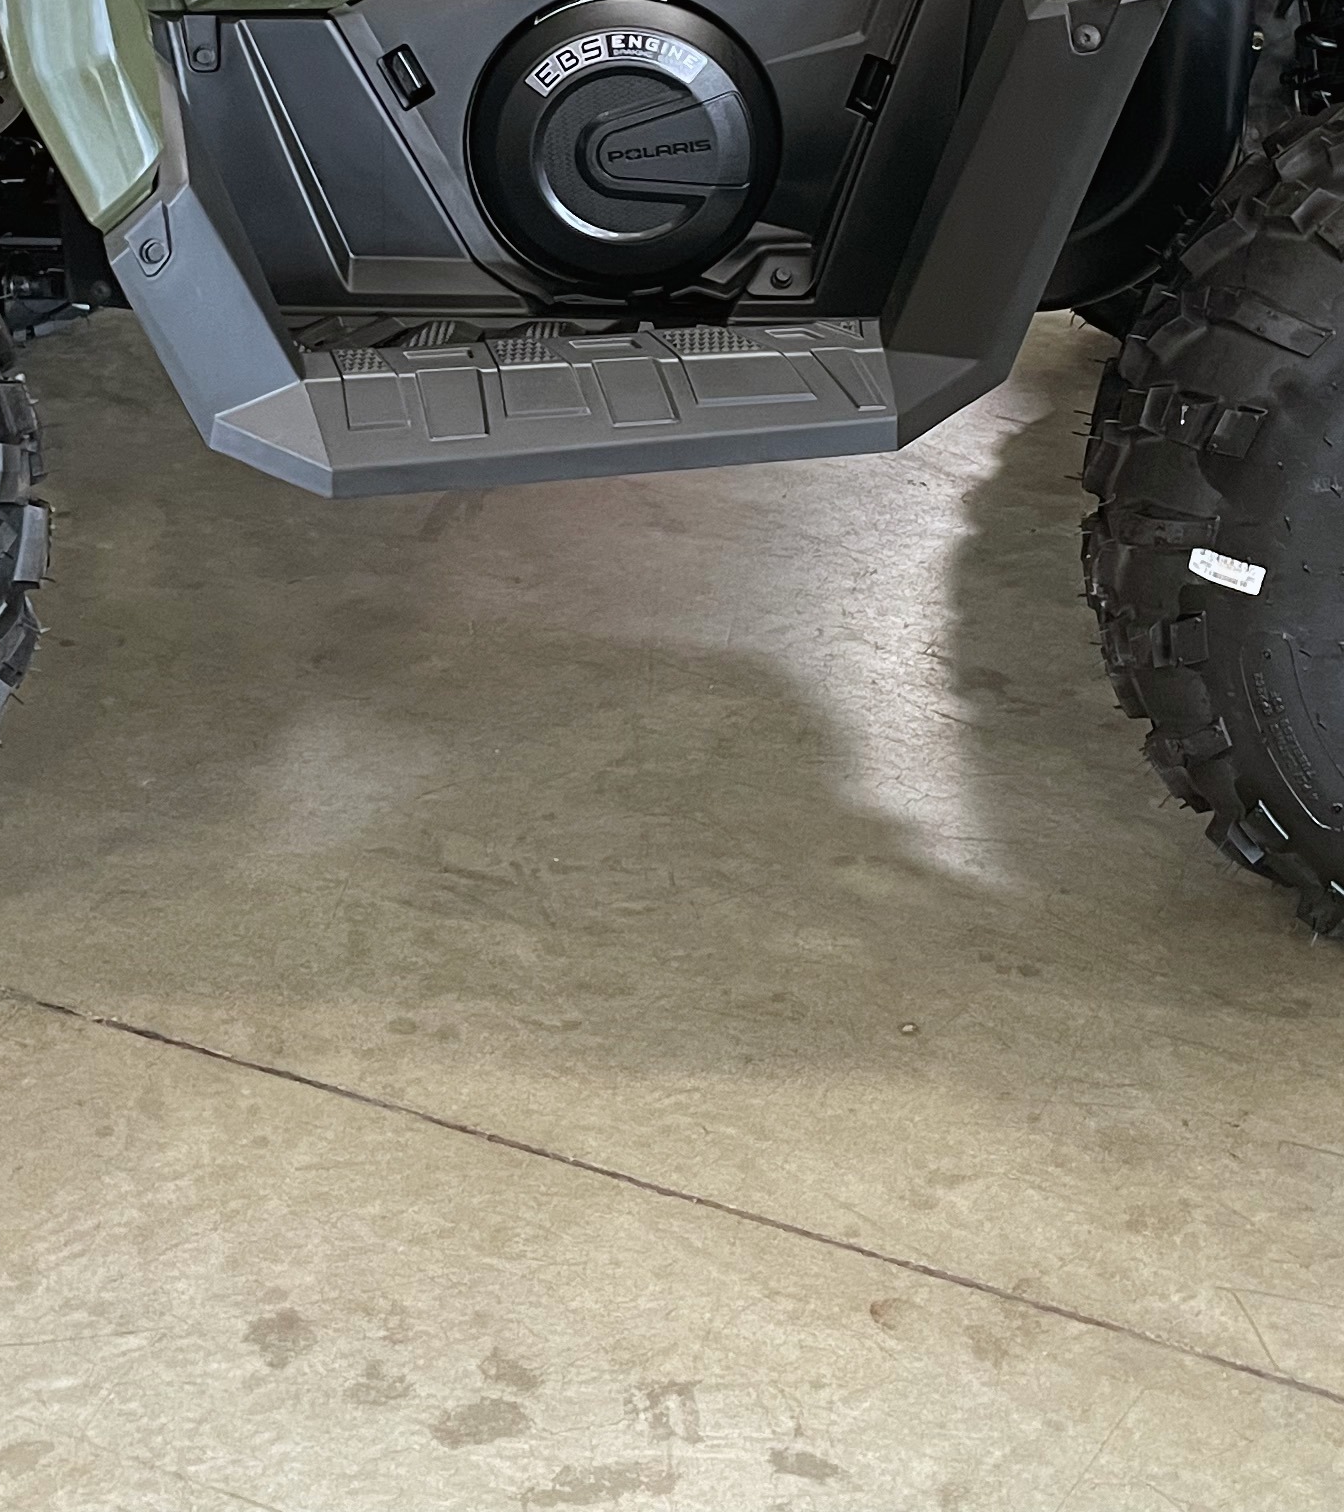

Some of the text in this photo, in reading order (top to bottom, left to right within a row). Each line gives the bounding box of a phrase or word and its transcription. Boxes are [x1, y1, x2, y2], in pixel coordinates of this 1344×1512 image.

[534, 37, 602, 88] EBS
[611, 34, 699, 69] ENGINE
[607, 139, 712, 163] POLARIS
